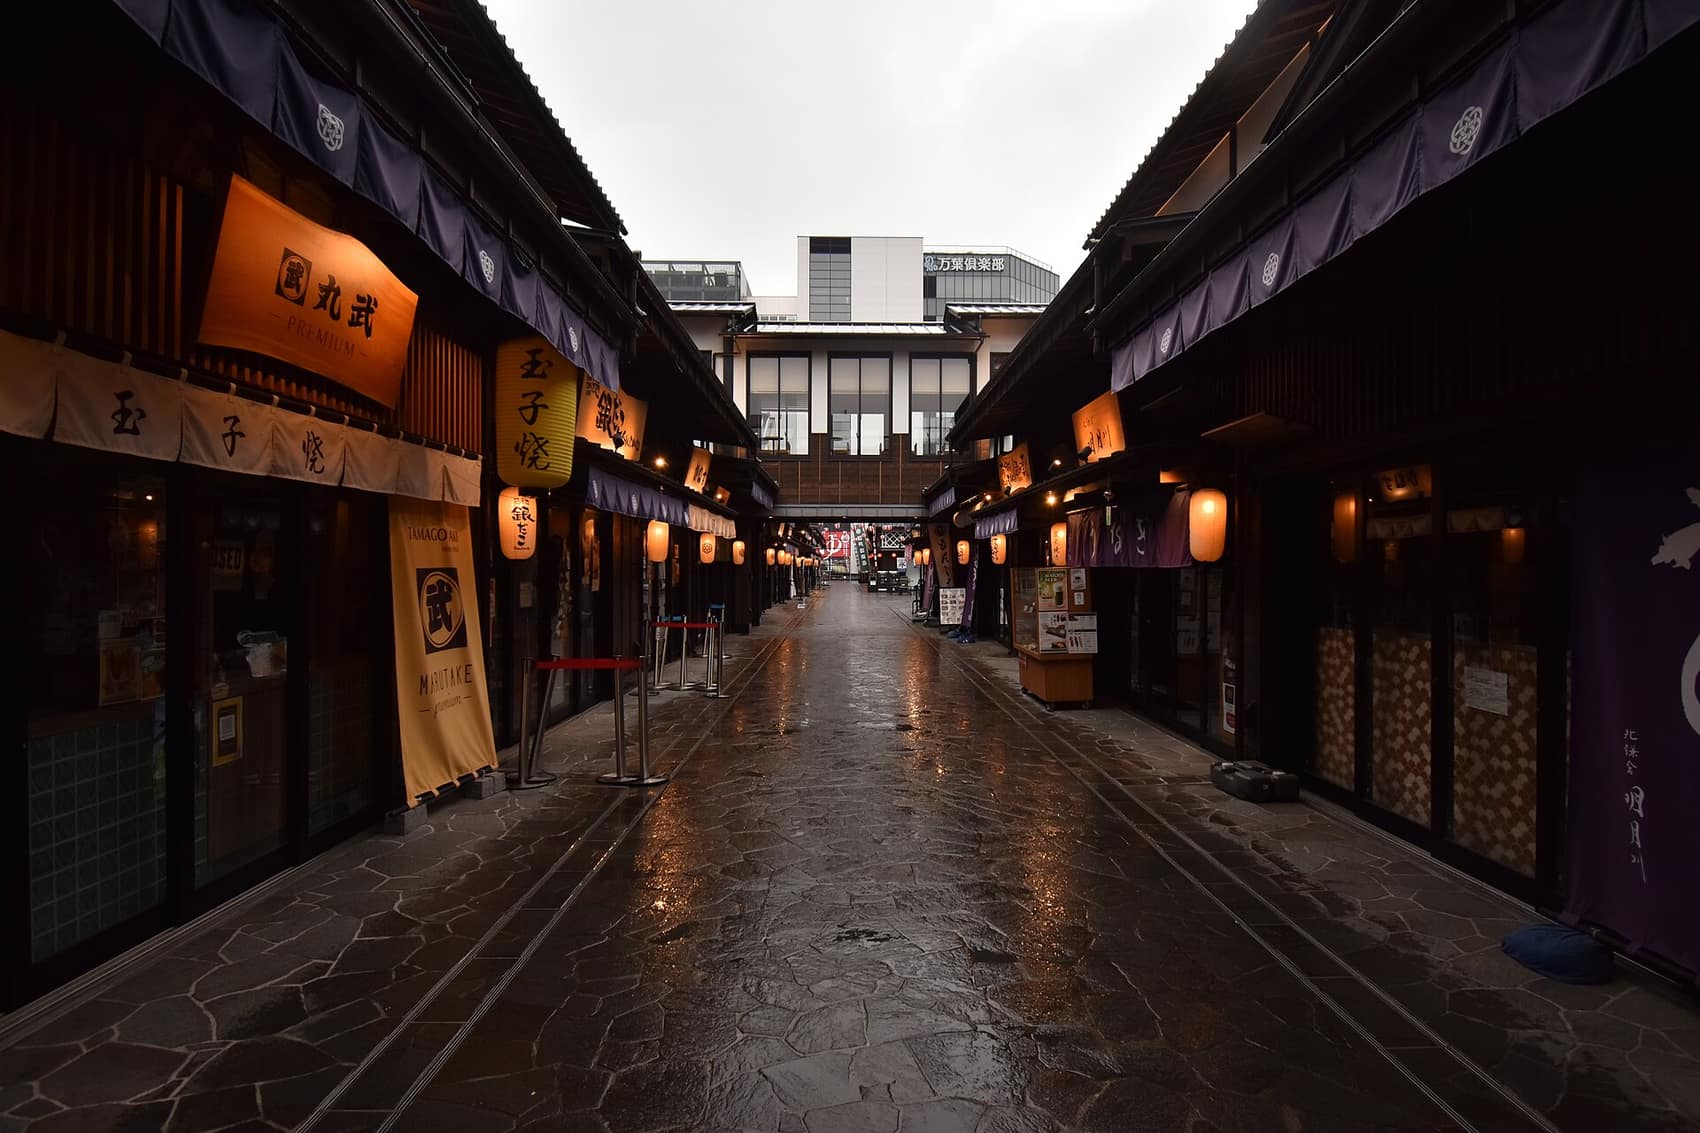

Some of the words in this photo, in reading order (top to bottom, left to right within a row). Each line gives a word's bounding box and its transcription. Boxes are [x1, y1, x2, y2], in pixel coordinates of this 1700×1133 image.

[312, 273, 378, 339] 丸武
[287, 315, 356, 357] PREMIUM
[418, 663, 473, 696] MARUTAKE
